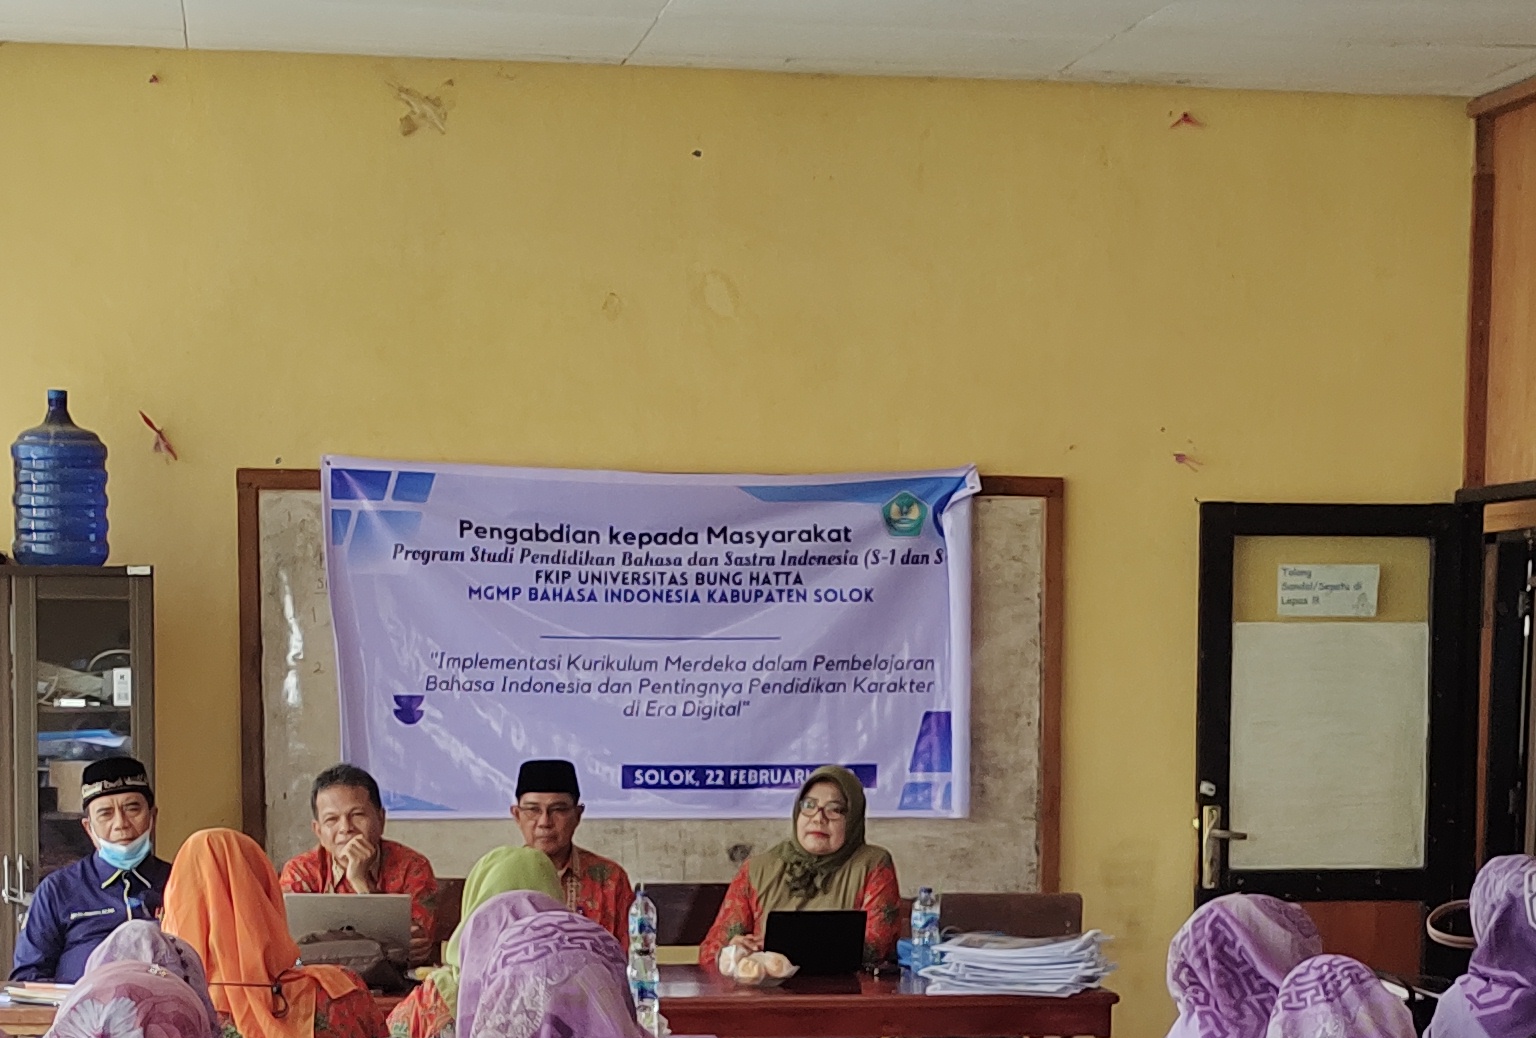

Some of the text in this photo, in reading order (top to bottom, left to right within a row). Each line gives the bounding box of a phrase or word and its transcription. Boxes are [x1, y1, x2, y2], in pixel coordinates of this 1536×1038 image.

[459, 519, 852, 549] Pengabdian kepada Masyarakat
[392, 543, 464, 565] Program
[470, 546, 513, 564] Studi
[520, 548, 615, 566] Pendidikan
[622, 550, 682, 566] Bahasa
[688, 550, 718, 566] dan
[724, 551, 775, 567] Sastra
[780, 549, 858, 566] Indonesia
[864, 548, 896, 569] (S-1
[901, 548, 929, 565] dan
[535, 570, 803, 586] FKIP UNIVERSITAS BUNG HATTA
[468, 586, 874, 603] MGMP BAHASA INDONESIA KABUPATEN SOLOK
[430, 652, 935, 674] "Implementasi Kurikulum Merdeka dalam Pembelajaran
[425, 675, 935, 698] Bahasa Indonesia dan Pentingnya Pendidikan Karakter
[623, 700, 751, 720] di Era Digital"
[634, 768, 700, 786] SOLOK,
[705, 768, 725, 785] 22
